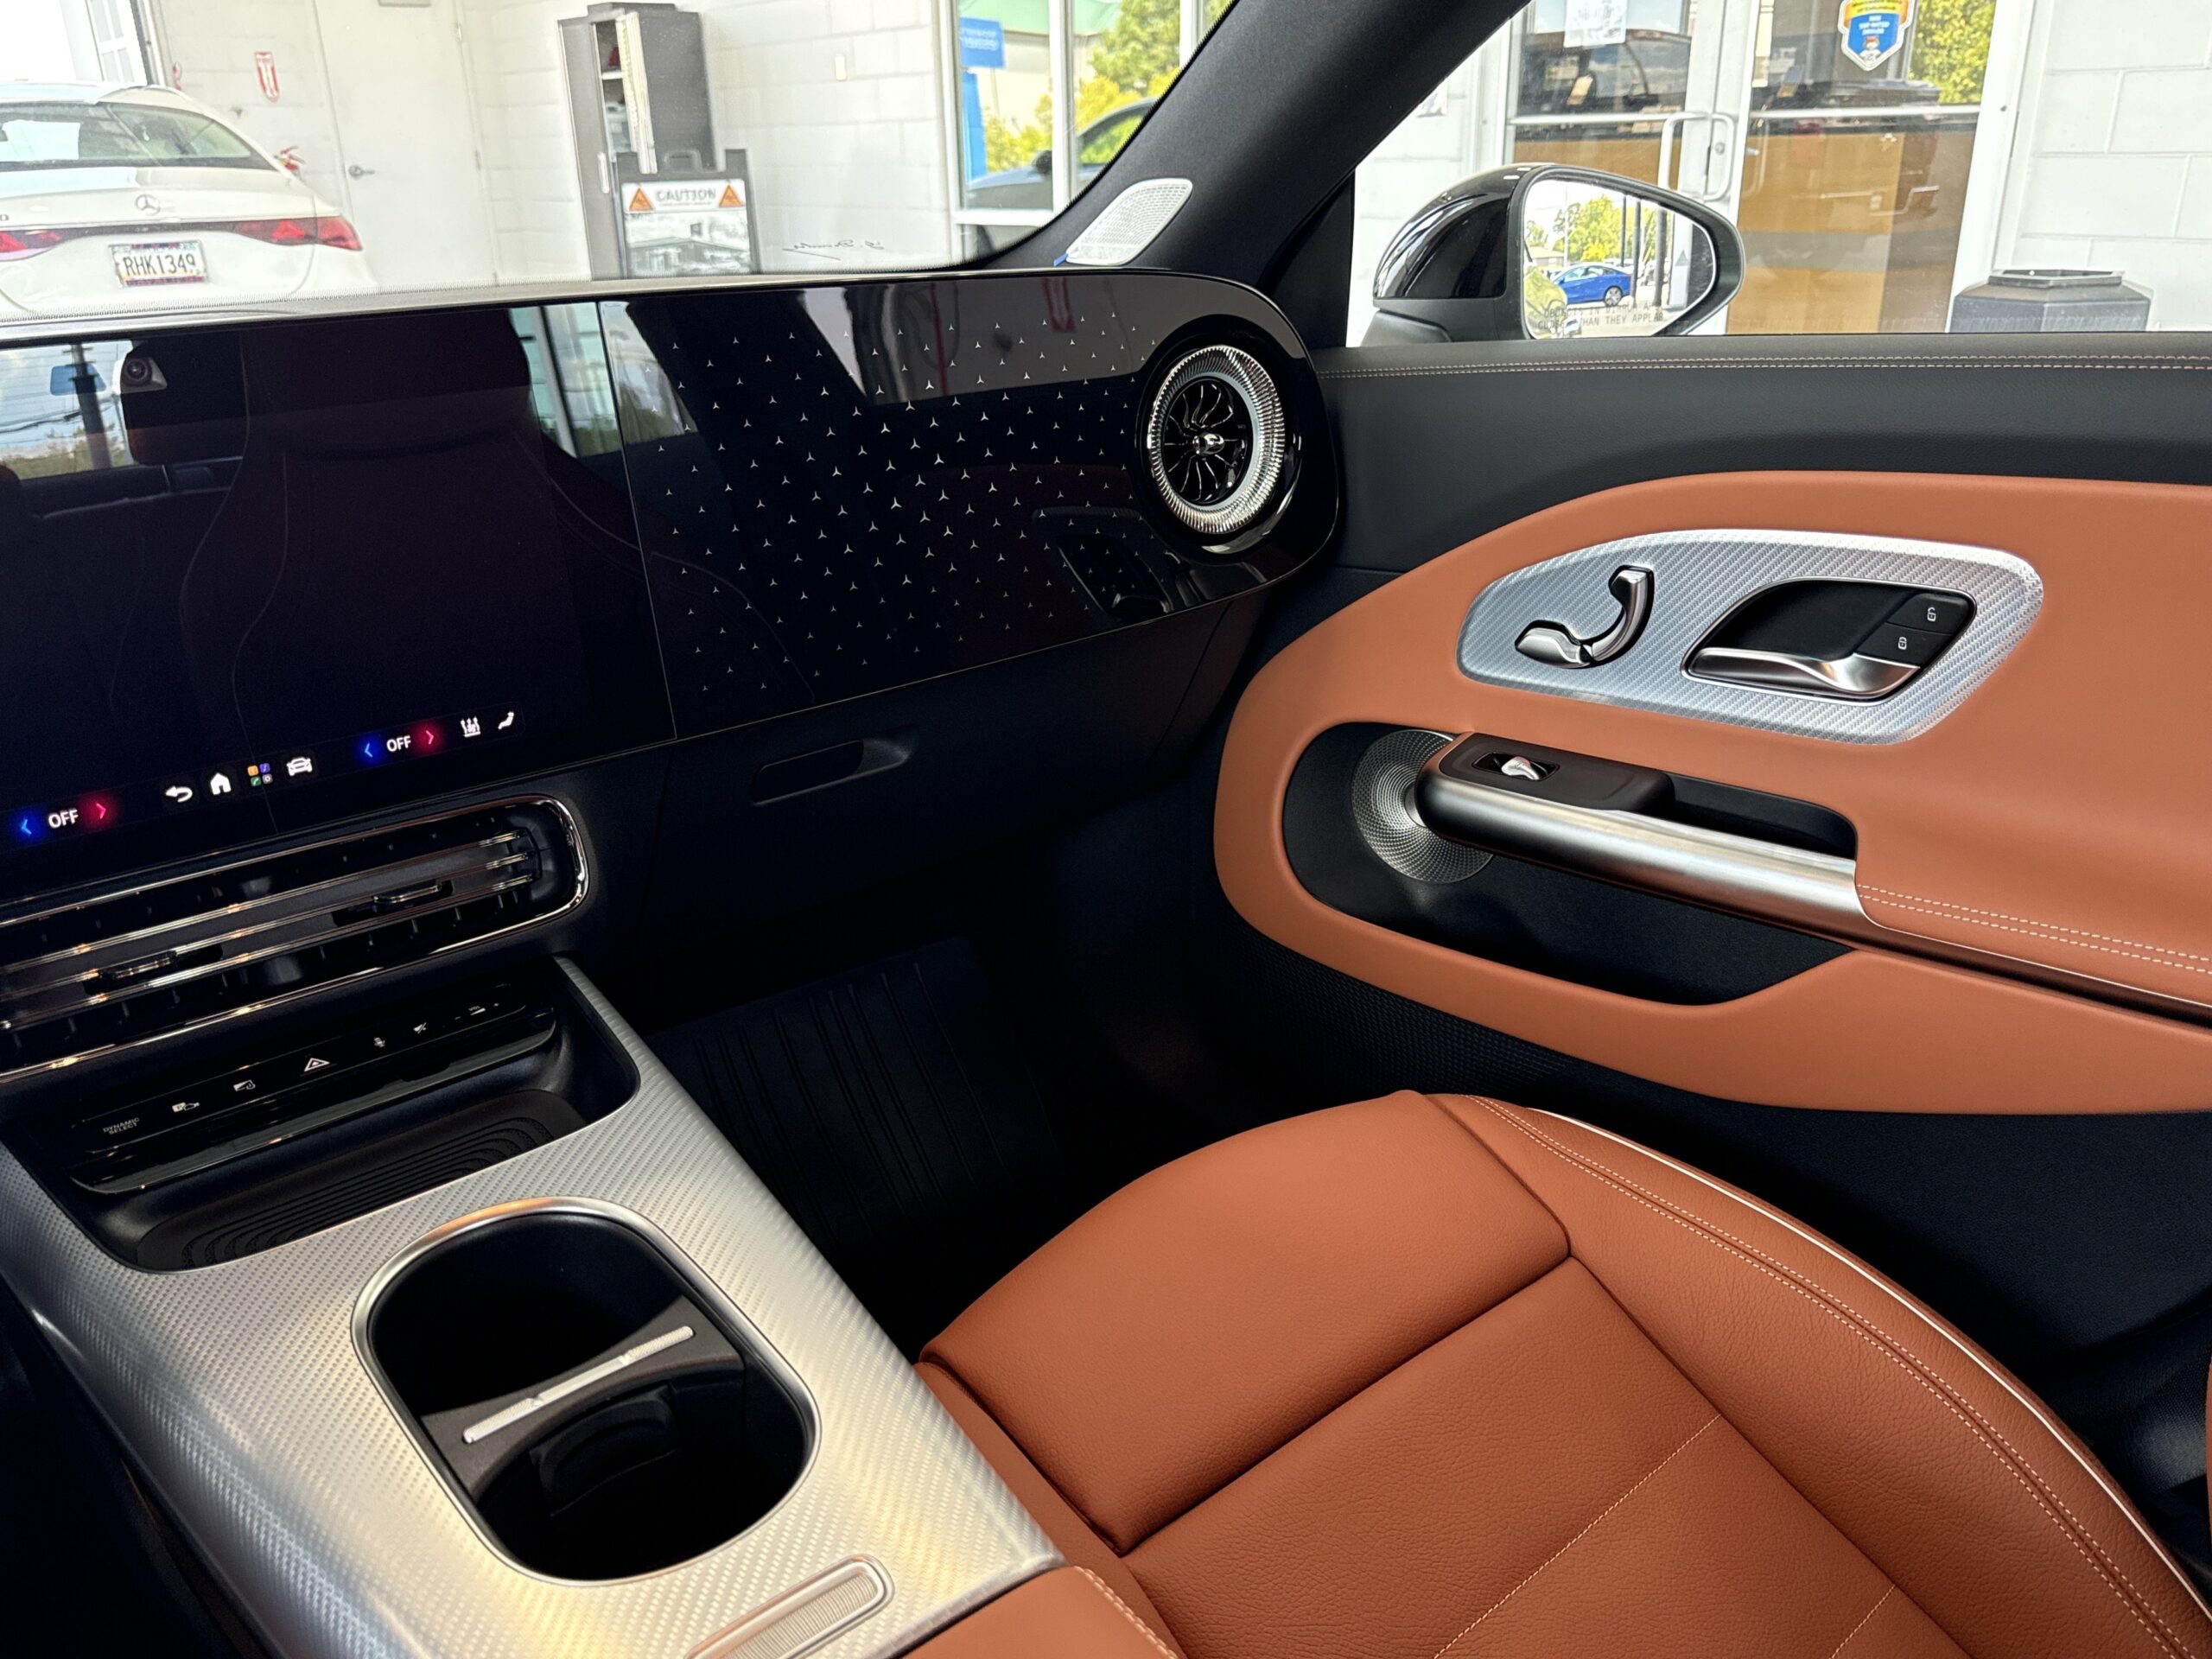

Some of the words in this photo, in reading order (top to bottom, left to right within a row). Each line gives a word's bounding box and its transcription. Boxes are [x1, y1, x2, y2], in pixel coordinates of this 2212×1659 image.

[655, 188, 715, 203] CAUTION
[1605, 315, 1628, 325] THEY
[387, 735, 411, 752] OFF
[48, 809, 79, 828] OFF
[104, 1117, 139, 1132] DYNAMIC
[109, 1123, 137, 1135] SELECT
